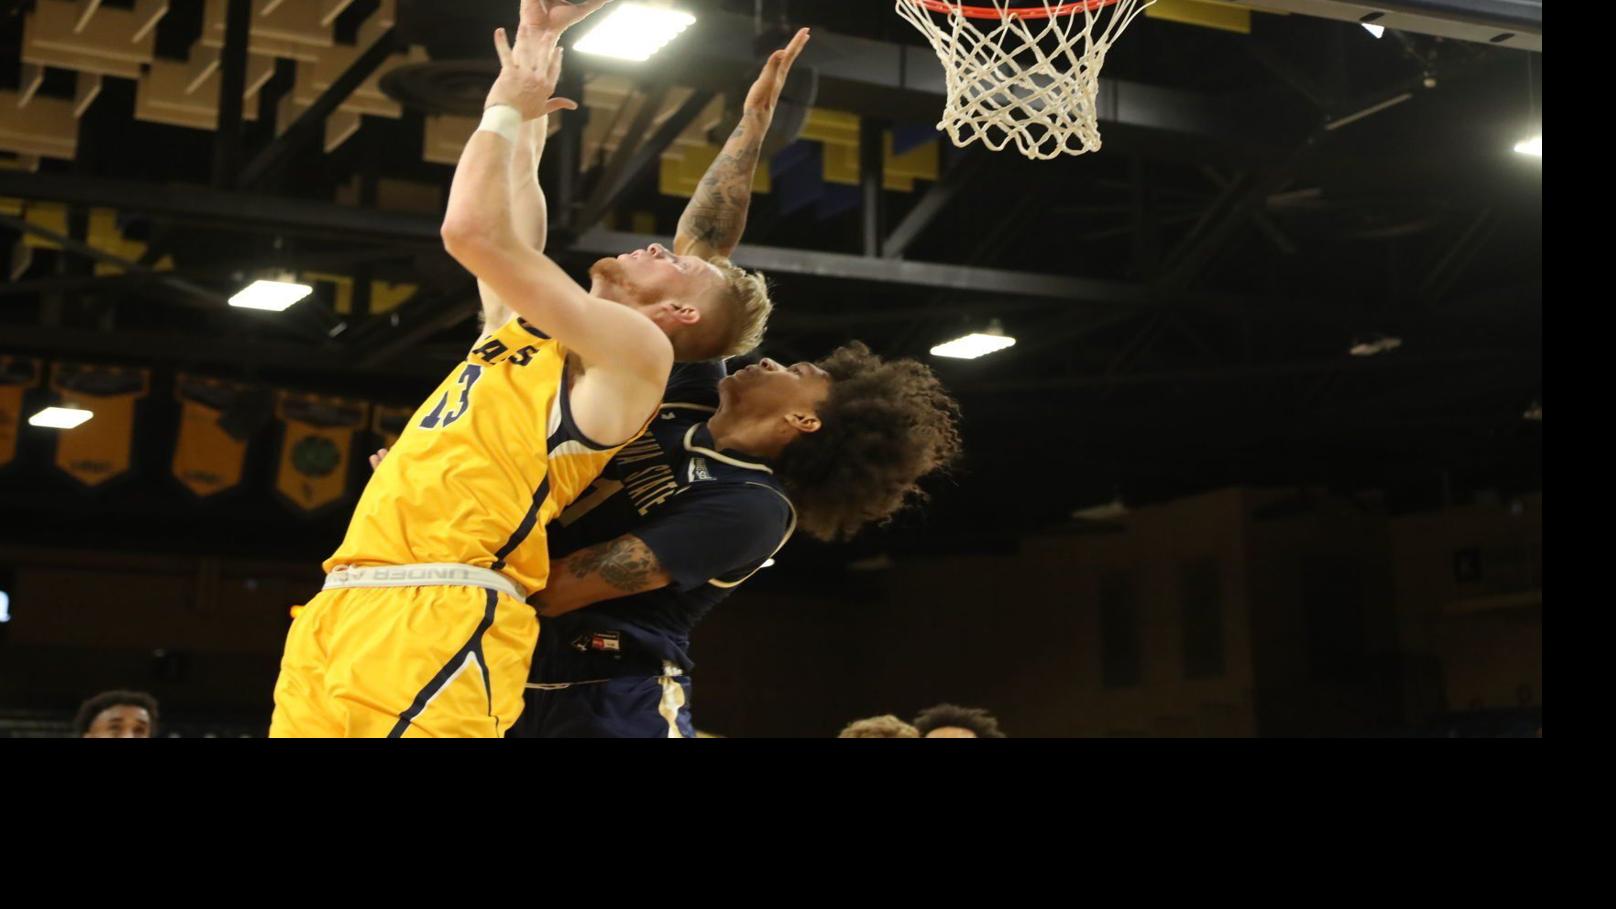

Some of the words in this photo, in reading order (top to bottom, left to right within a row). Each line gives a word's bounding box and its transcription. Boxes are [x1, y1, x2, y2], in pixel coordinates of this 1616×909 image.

[419, 363, 483, 429] 13
[623, 464, 678, 516] STATE
[373, 567, 470, 581] UNDER
